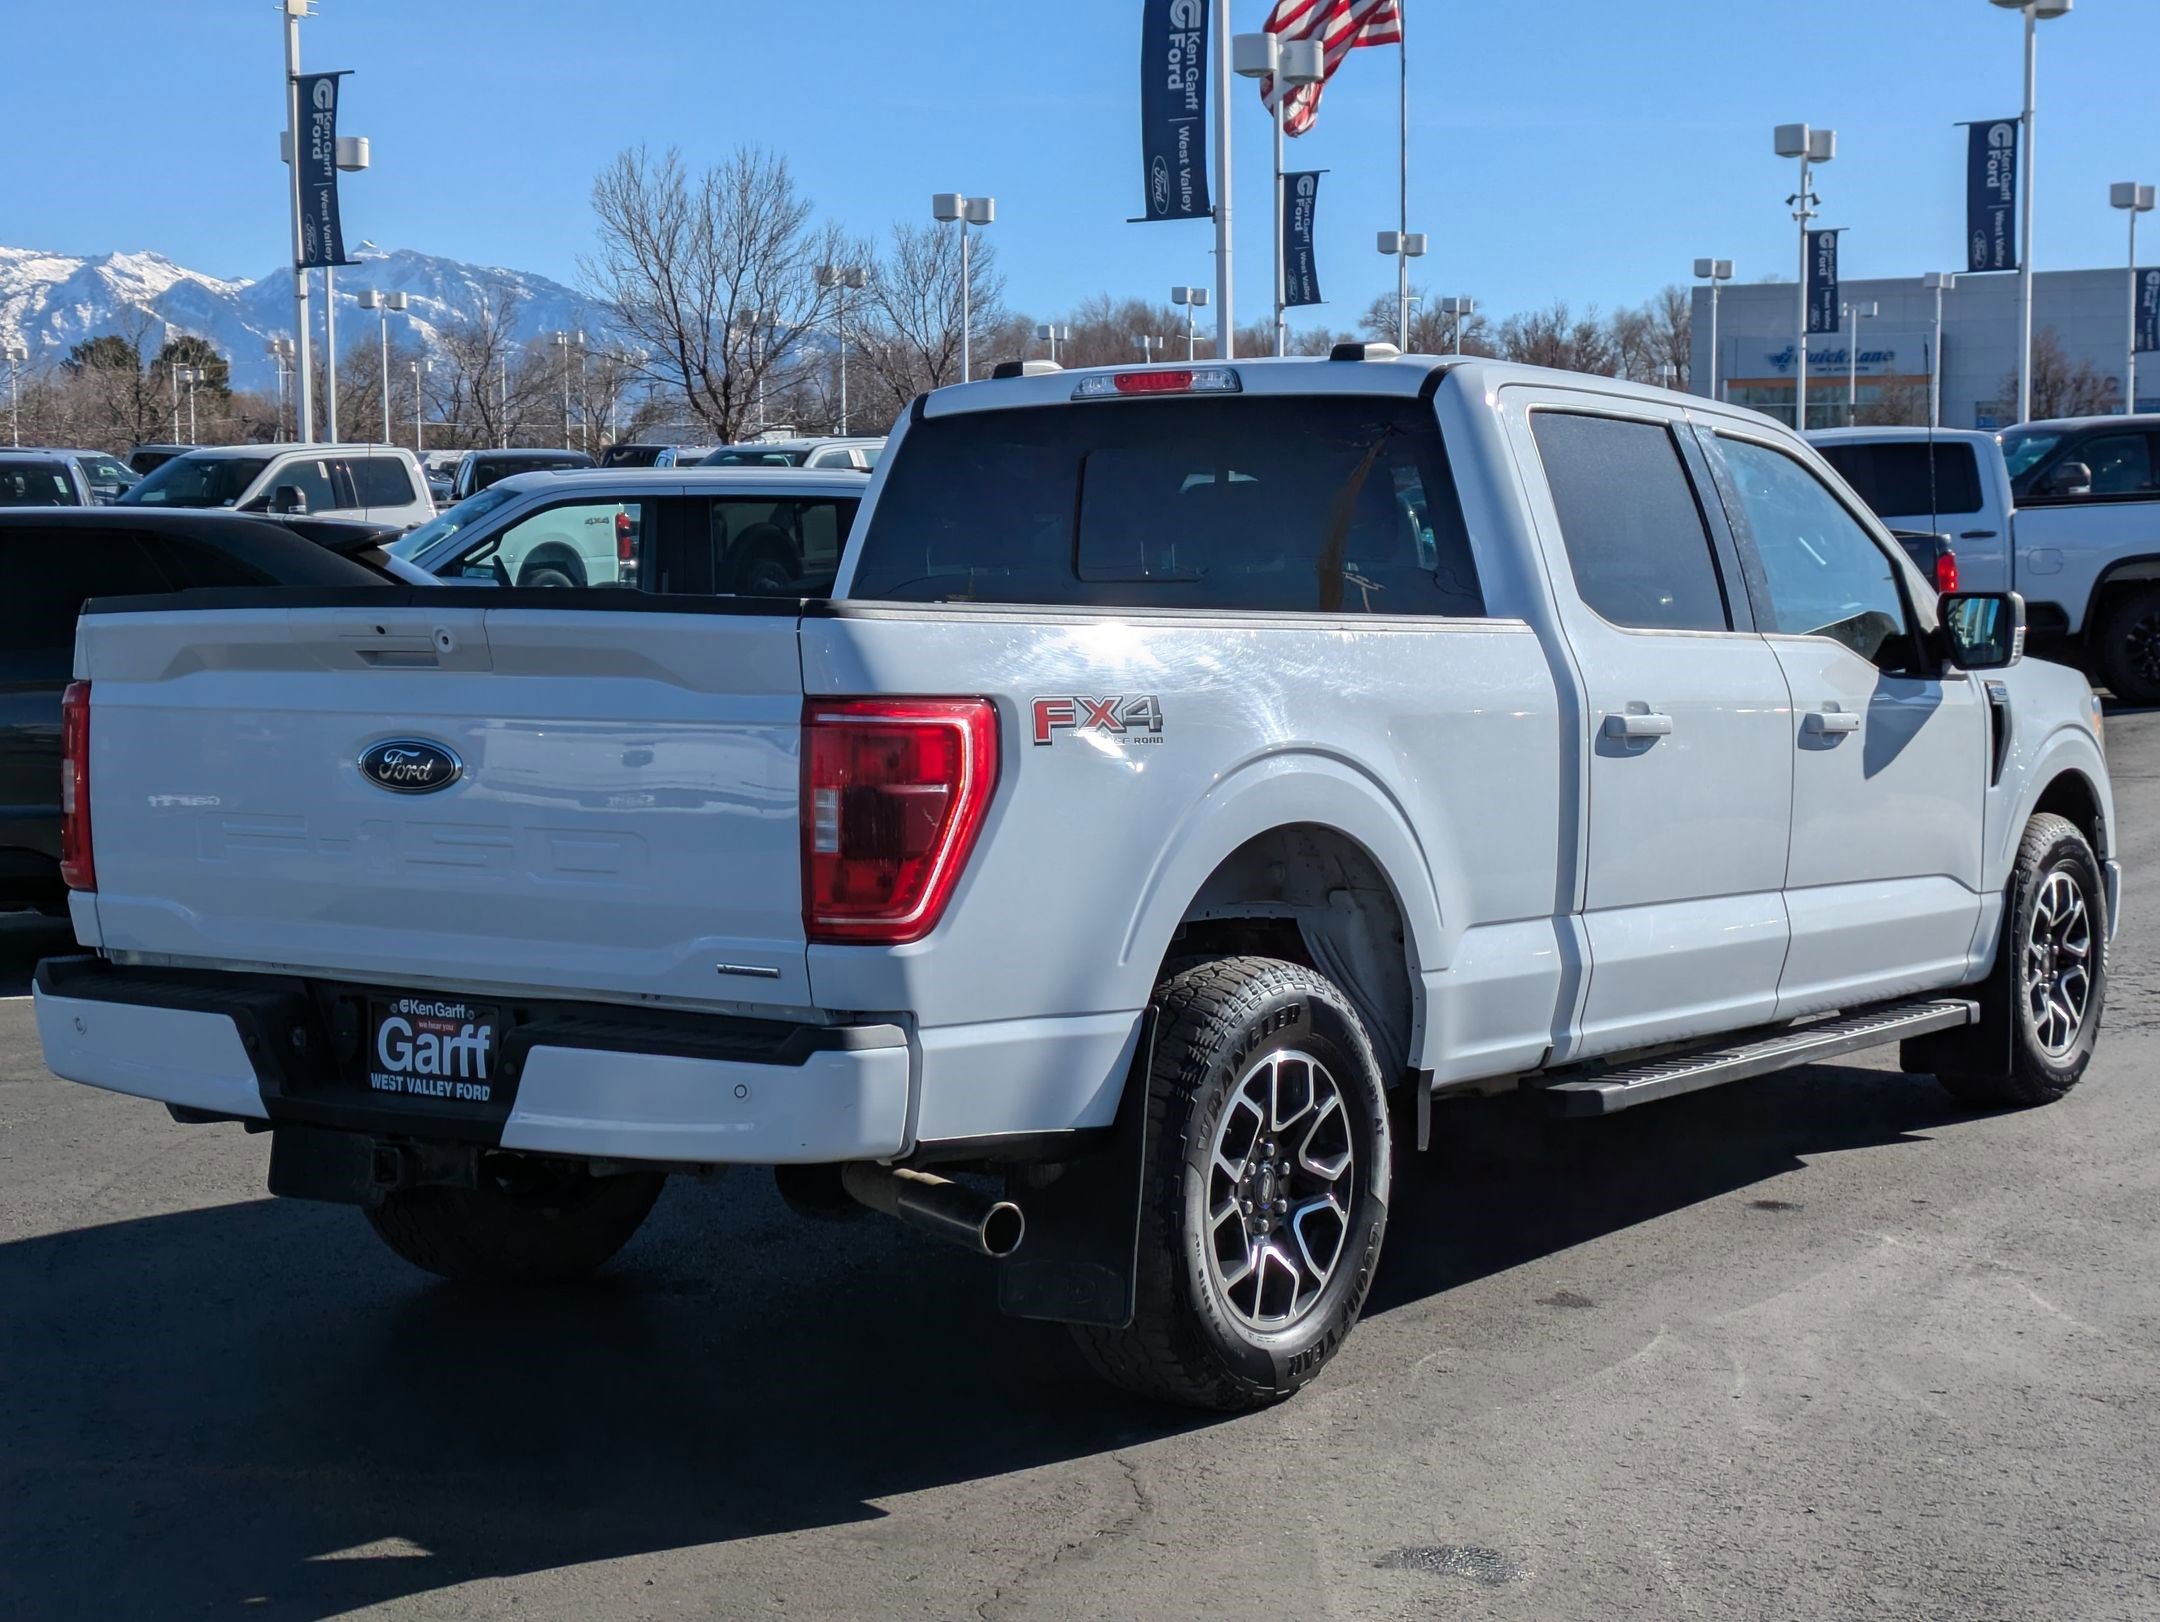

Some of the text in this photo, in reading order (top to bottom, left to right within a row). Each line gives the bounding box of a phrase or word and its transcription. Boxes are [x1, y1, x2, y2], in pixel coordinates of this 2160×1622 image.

[1167, 33, 1186, 90] Ford
[1185, 31, 1200, 110] Ken Garff
[312, 113, 324, 160] Ford
[323, 112, 333, 177] Ken Garff
[1154, 166, 1167, 202] Ford
[1178, 126, 1193, 212] West Valley
[1987, 150, 2001, 188] Ford
[2001, 148, 2012, 201] Ken Garff
[305, 223, 316, 253] Ford
[319, 189, 334, 261] West Valley
[1295, 199, 1304, 231] Ford
[1303, 197, 1312, 242] Ken Garff
[1994, 210, 2005, 268] West Valley
[1818, 250, 1828, 276] Ford
[1302, 275, 1311, 301] Valley
[1030, 694, 1163, 746] FX4
[1134, 736, 1164, 744] ROAD
[378, 748, 434, 781] Ford
[410, 1000, 434, 1016] Ken
[434, 1002, 465, 1019] Garff
[427, 1021, 442, 1030] hear
[442, 1023, 454, 1032] you
[377, 1016, 491, 1079] Garff
[370, 1072, 491, 1102] WEST VALLEY FORD
[1197, 1002, 1300, 1151] WRANGLER
[1286, 1222, 1382, 1378] GOODYEAR
